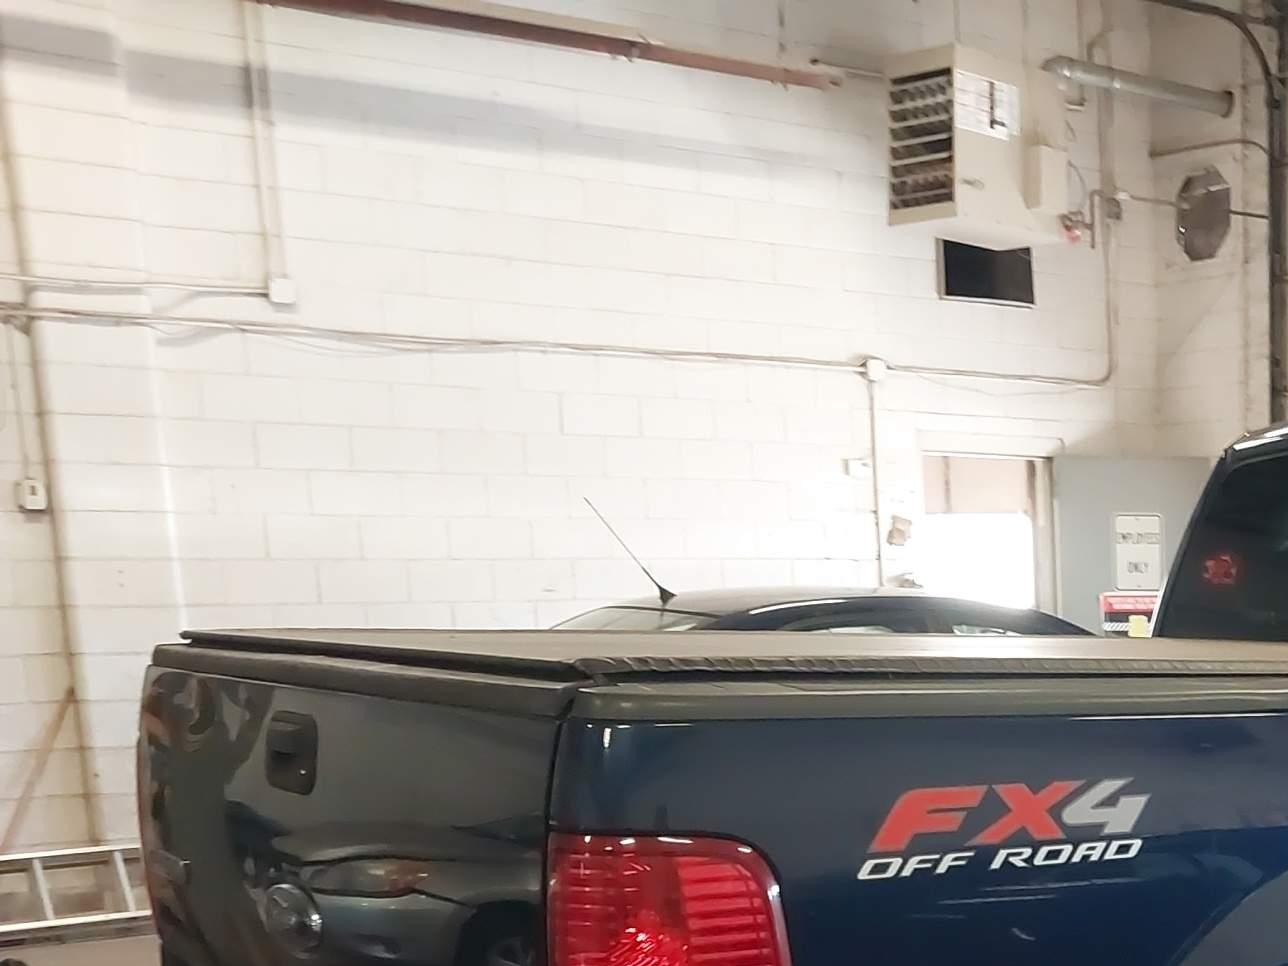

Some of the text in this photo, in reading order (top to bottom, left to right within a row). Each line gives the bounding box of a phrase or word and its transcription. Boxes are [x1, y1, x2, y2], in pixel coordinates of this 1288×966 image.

[868, 777, 1151, 854] FX4
[857, 838, 1143, 880] OFF ROAD
